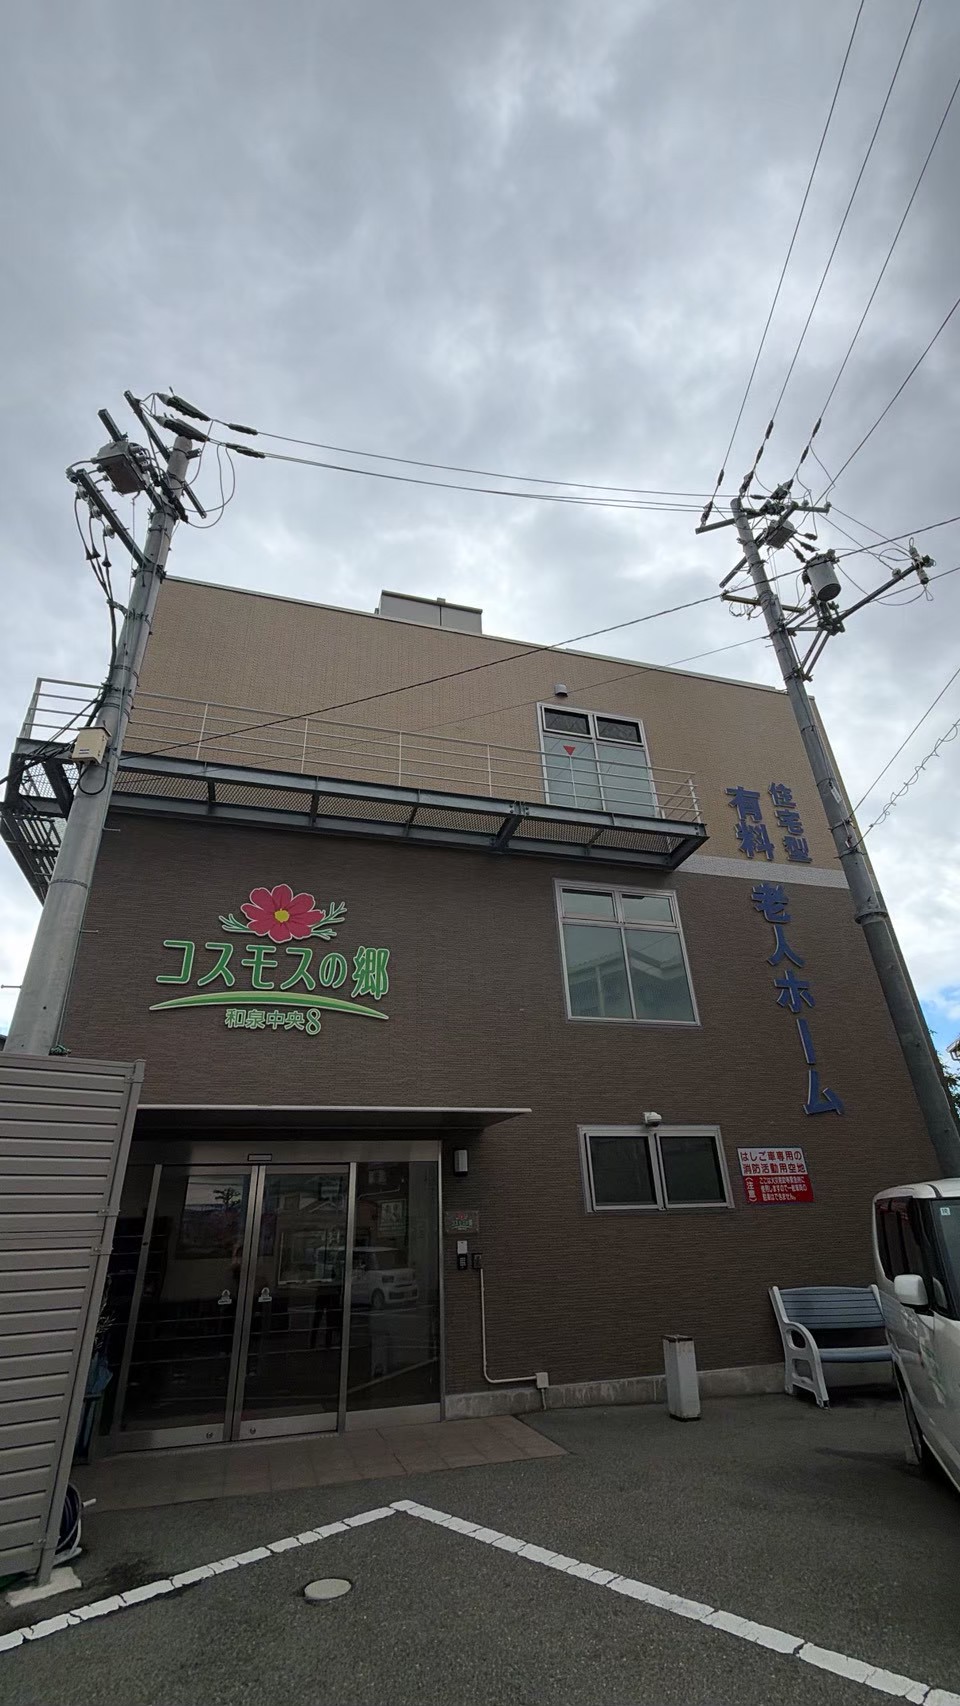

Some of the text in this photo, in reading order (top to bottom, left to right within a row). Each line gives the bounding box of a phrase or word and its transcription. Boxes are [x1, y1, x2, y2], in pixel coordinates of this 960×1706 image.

[767, 782, 813, 864] 住宅型
[155, 939, 391, 1000] コスモスの郷
[224, 1008, 322, 1036] 和泉中央8
[740, 1150, 802, 1161] はしご車専用の
[742, 1162, 806, 1174] 消防活動用空地
